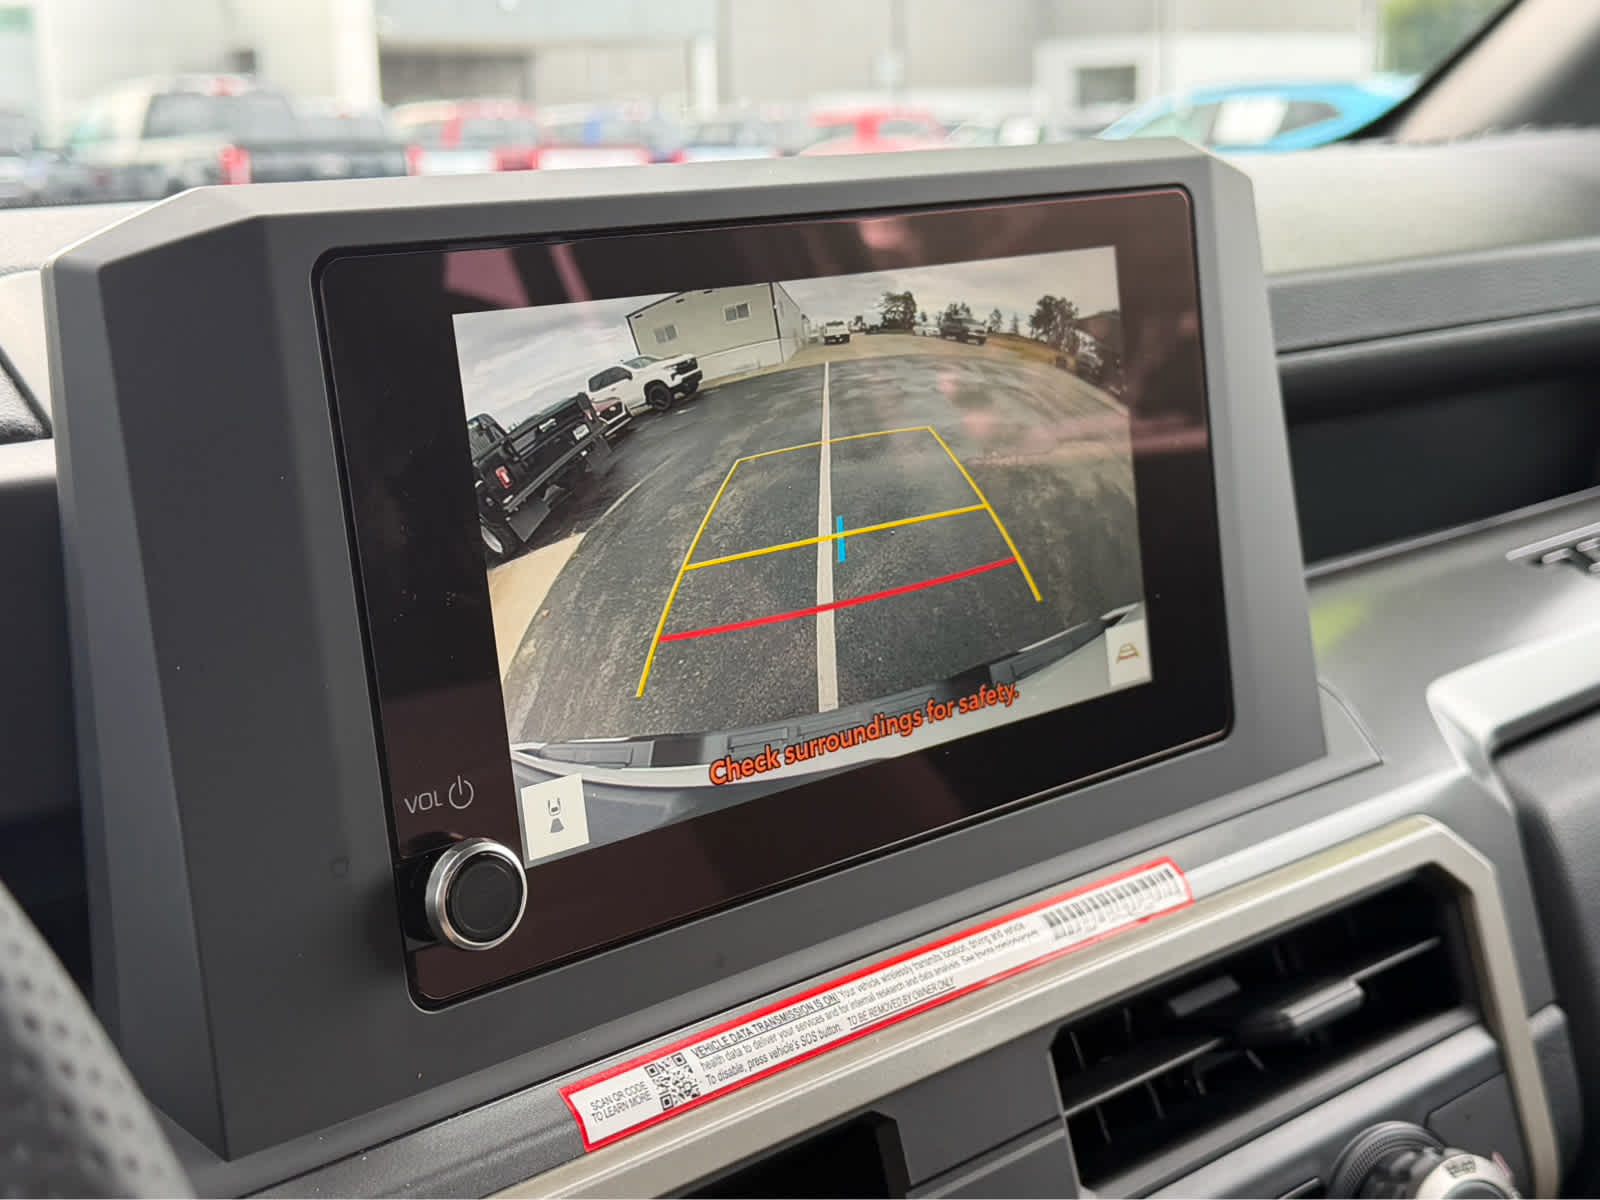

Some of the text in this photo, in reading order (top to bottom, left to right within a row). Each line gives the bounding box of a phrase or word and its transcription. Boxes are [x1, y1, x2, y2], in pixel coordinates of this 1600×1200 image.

[709, 681, 1019, 786] Check surroundings for safety.
[405, 791, 442, 814] VOL
[690, 1036, 728, 1058] VEHICLE
[729, 1027, 753, 1044] DATA
[753, 1004, 814, 1036] TRANSMISSION
[813, 999, 824, 1011] IS
[824, 993, 839, 1006] ON!
[848, 976, 954, 1026] TO BE REMOVED BY OWNER ONLY
[701, 1051, 726, 1071] health
[725, 1044, 743, 1061] data
[743, 1042, 752, 1053] to
[752, 1034, 777, 1050] deliver
[779, 1027, 794, 1042] your
[796, 1016, 824, 1033] services
[705, 1023, 841, 1086] To disable, press vehicle's SOS button.
[589, 1094, 612, 1111] SCAN
[625, 1081, 649, 1098] CODE
[592, 1090, 651, 1124] TO LEARN MORE
